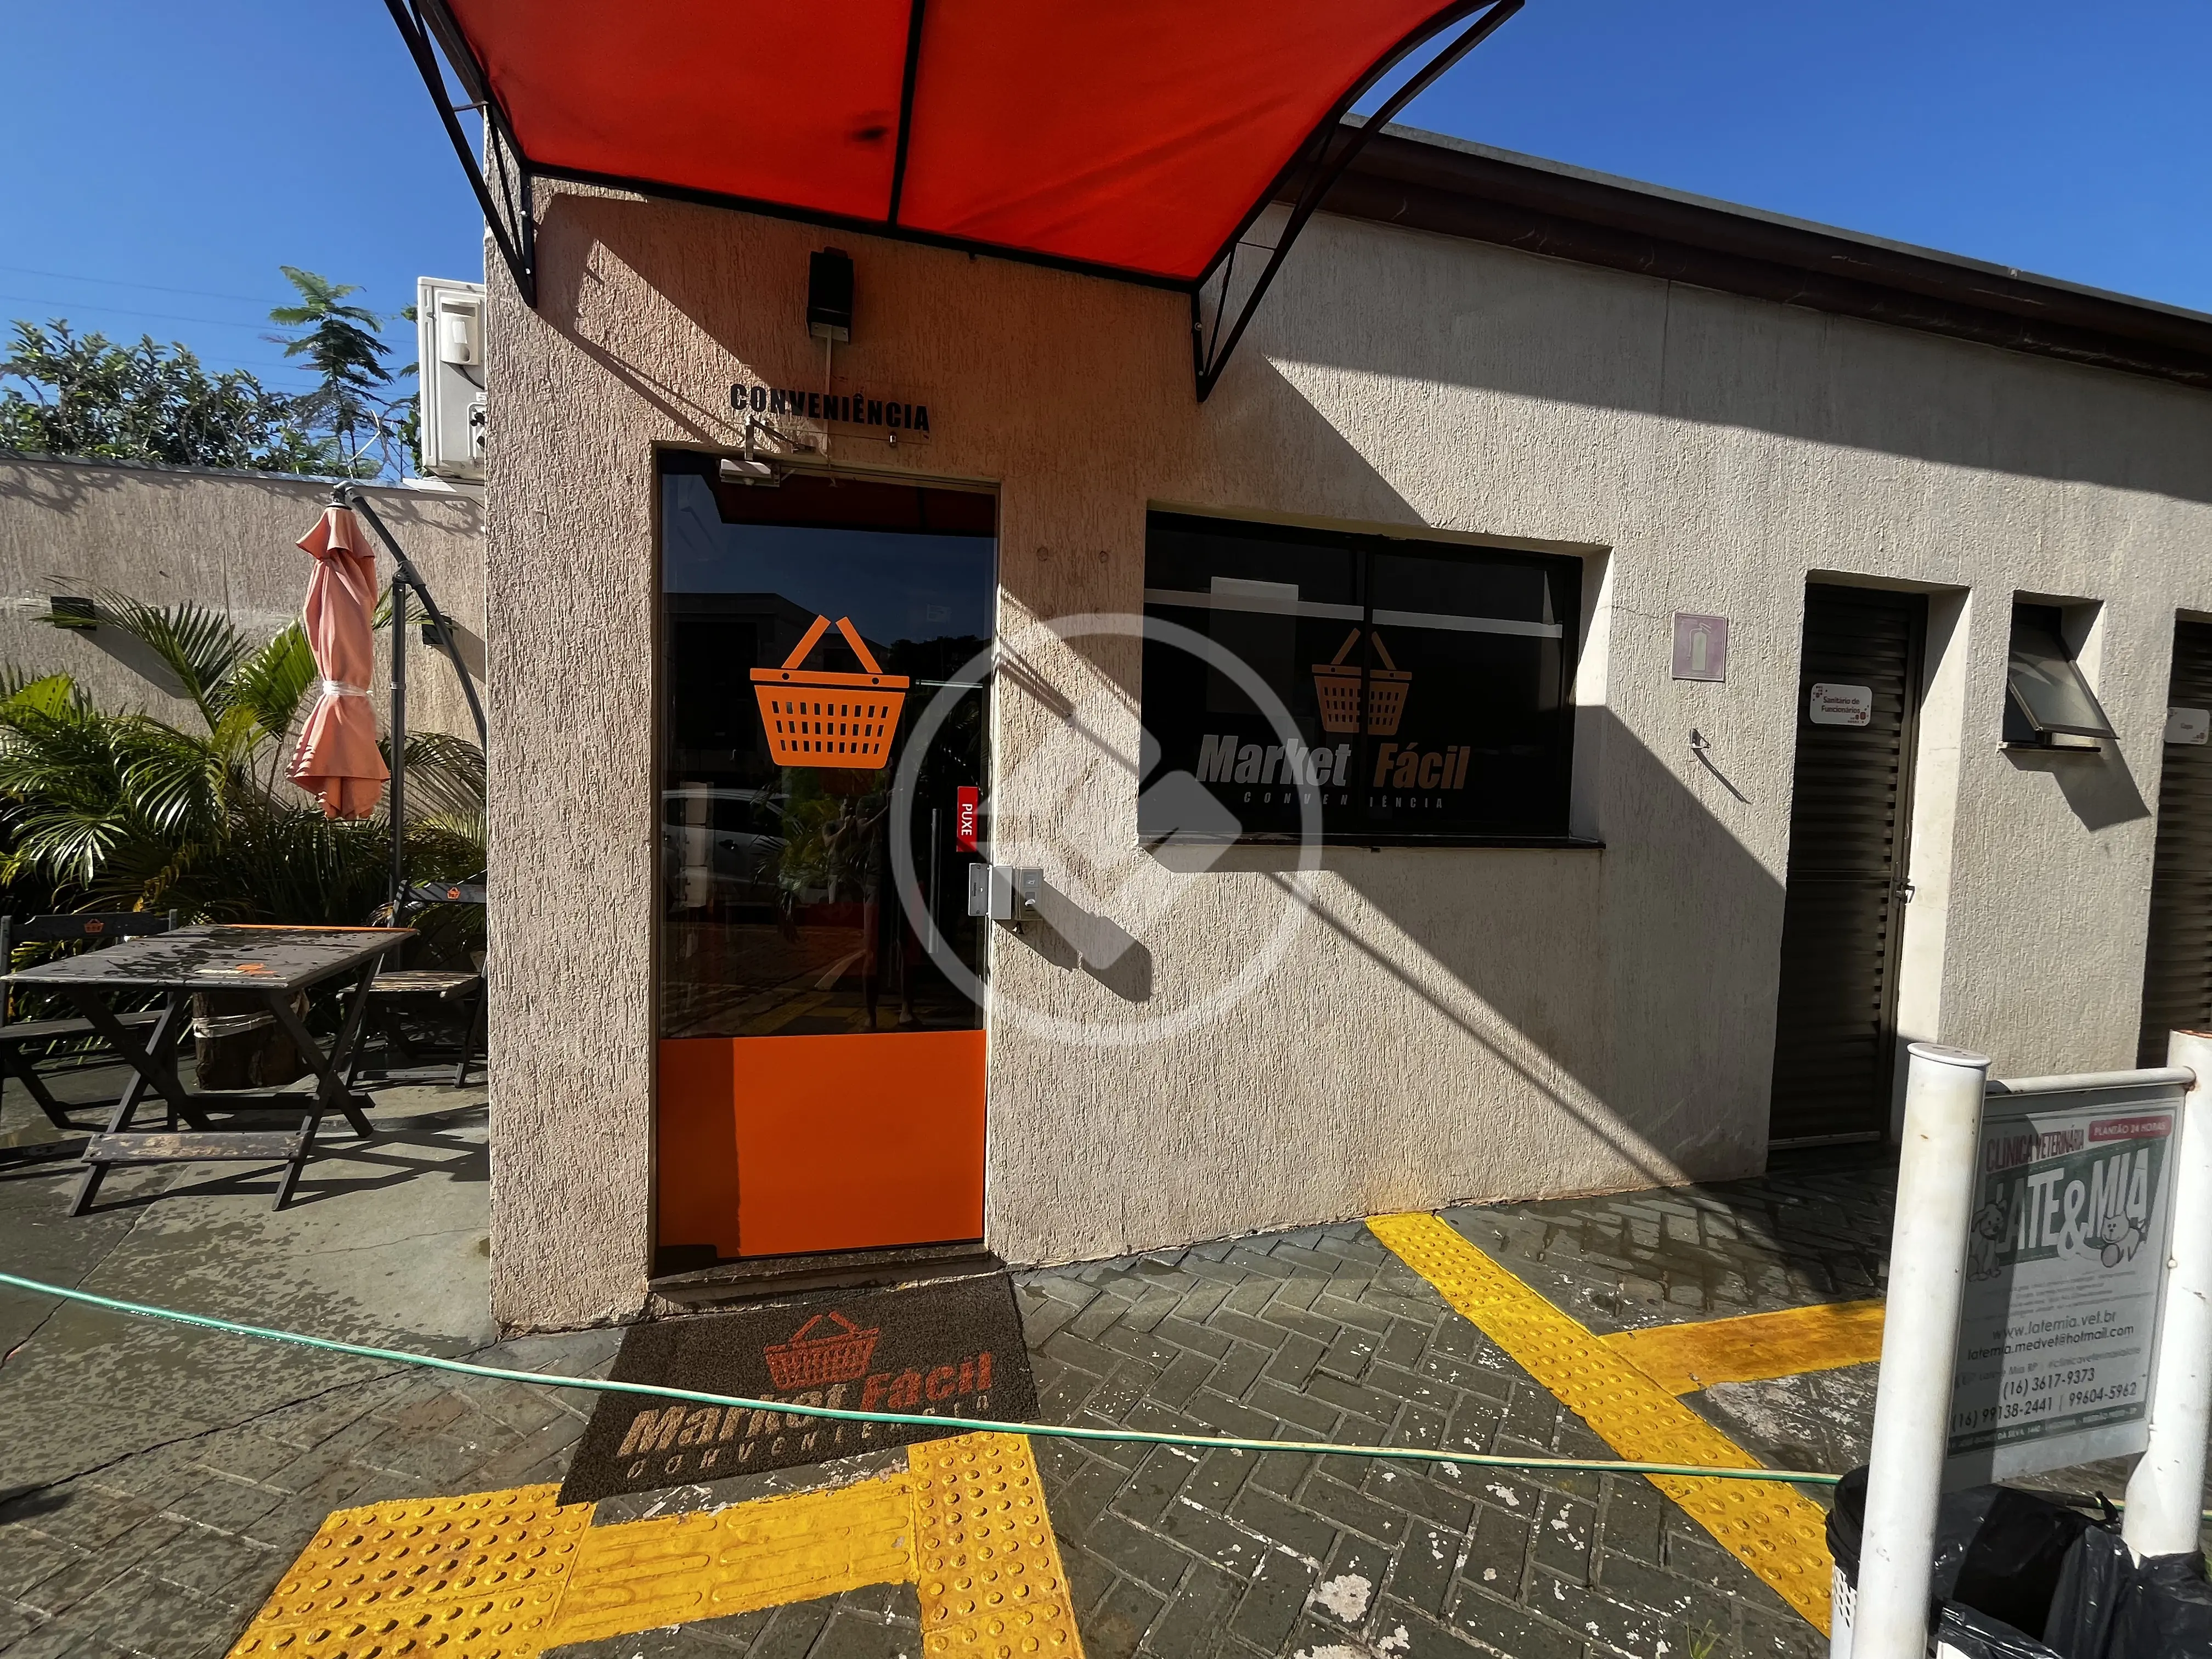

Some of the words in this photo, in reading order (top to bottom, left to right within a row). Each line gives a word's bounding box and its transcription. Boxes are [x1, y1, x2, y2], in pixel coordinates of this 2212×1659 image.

[730, 383, 930, 432] CONVENIÊNCIA
[1195, 734, 1351, 787] Market
[1373, 742, 1471, 789] Fácil
[961, 803, 973, 836] PUXE
[1985, 1131, 2033, 1172] CLÍNICA
[2003, 1378, 2029, 1400] (16)
[2032, 1367, 2095, 1392] 3617-9373
[1951, 1410, 1978, 1432] (16)
